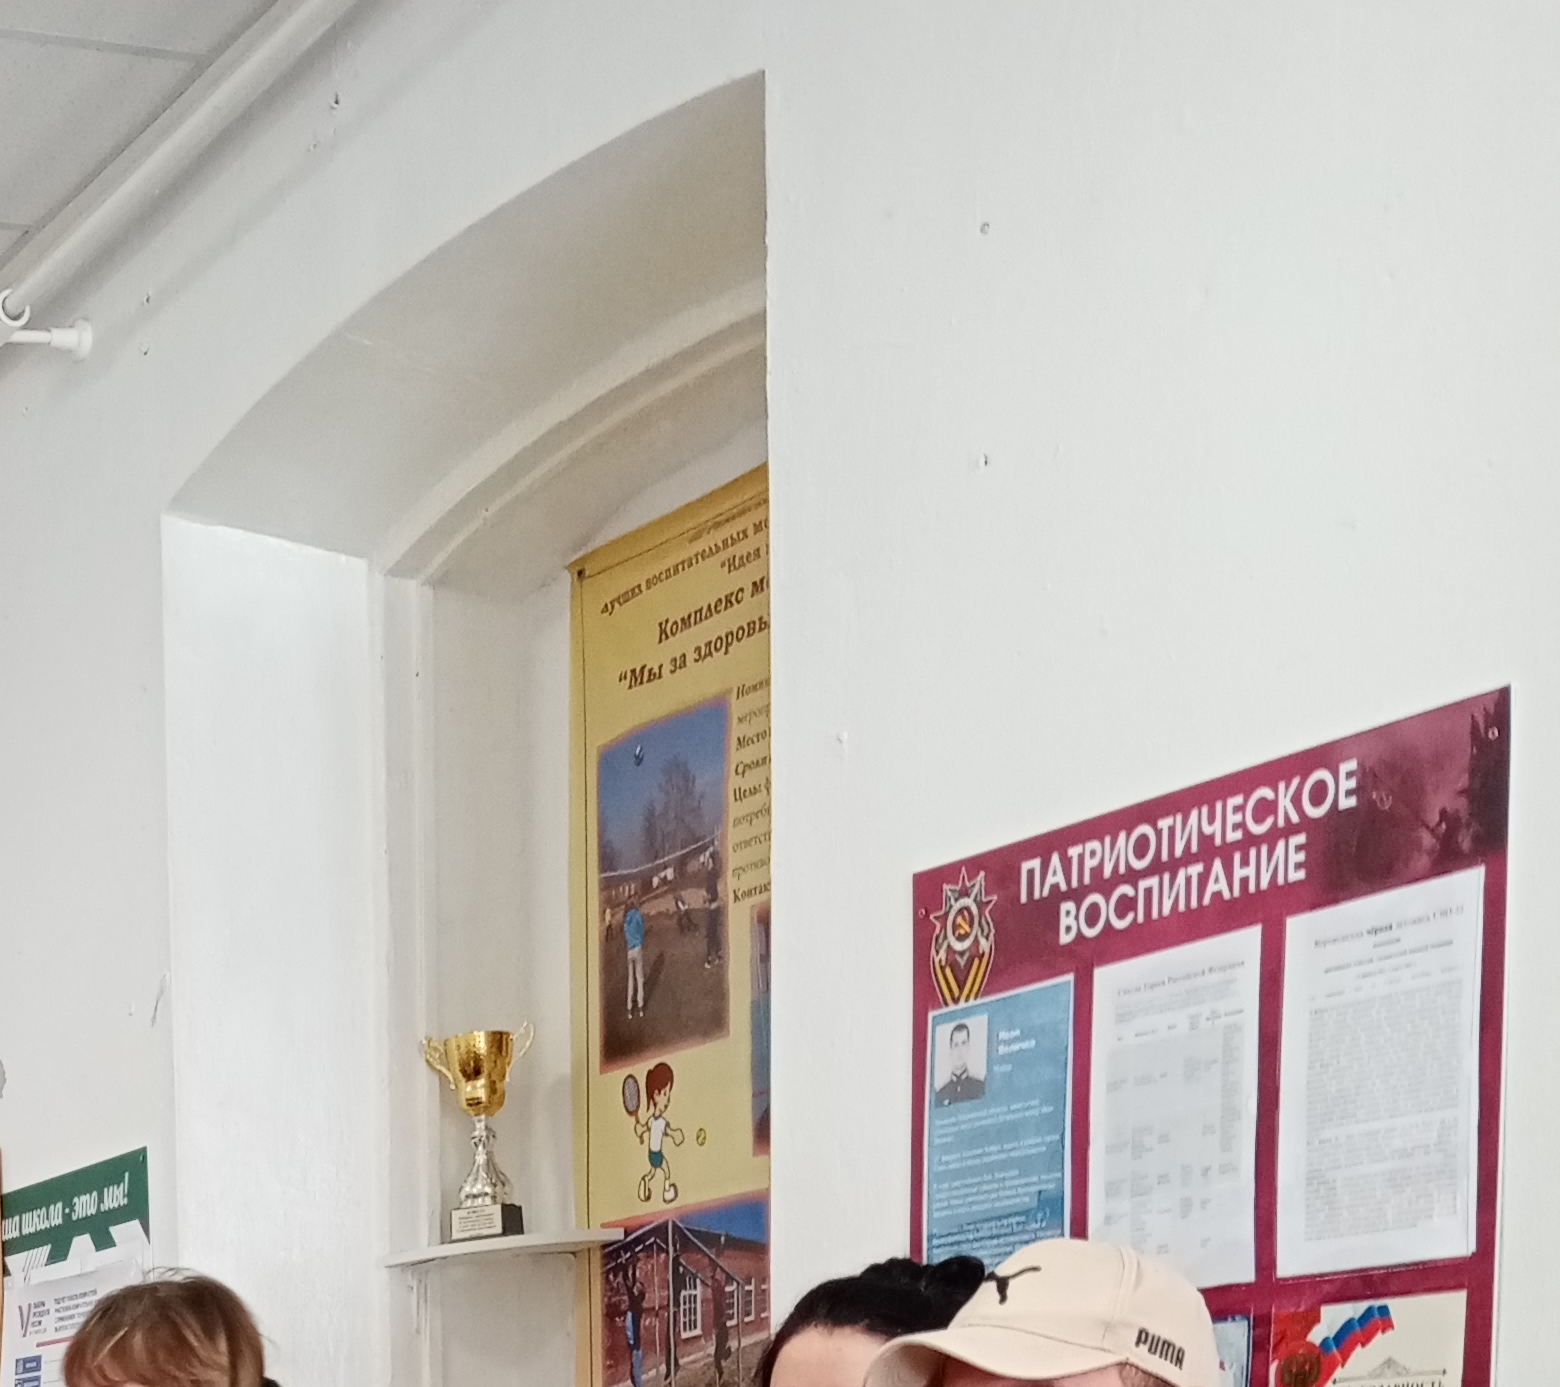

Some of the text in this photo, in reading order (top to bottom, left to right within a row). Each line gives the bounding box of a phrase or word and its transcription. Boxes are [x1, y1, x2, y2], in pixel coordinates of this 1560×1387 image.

[657, 586, 745, 645] Комплекс
[669, 651, 687, 674] за
[693, 615, 769, 664] здоровь
[1019, 758, 1359, 905] ПАТРИОТИЧЕСКОЕ
[1058, 833, 1308, 946] ВОСПИТАНИЕ
[21, 1201, 63, 1236] школа
[72, 1190, 98, 1221] это
[100, 1171, 130, 1214] мы!
[1134, 1327, 1185, 1371] PUMA
